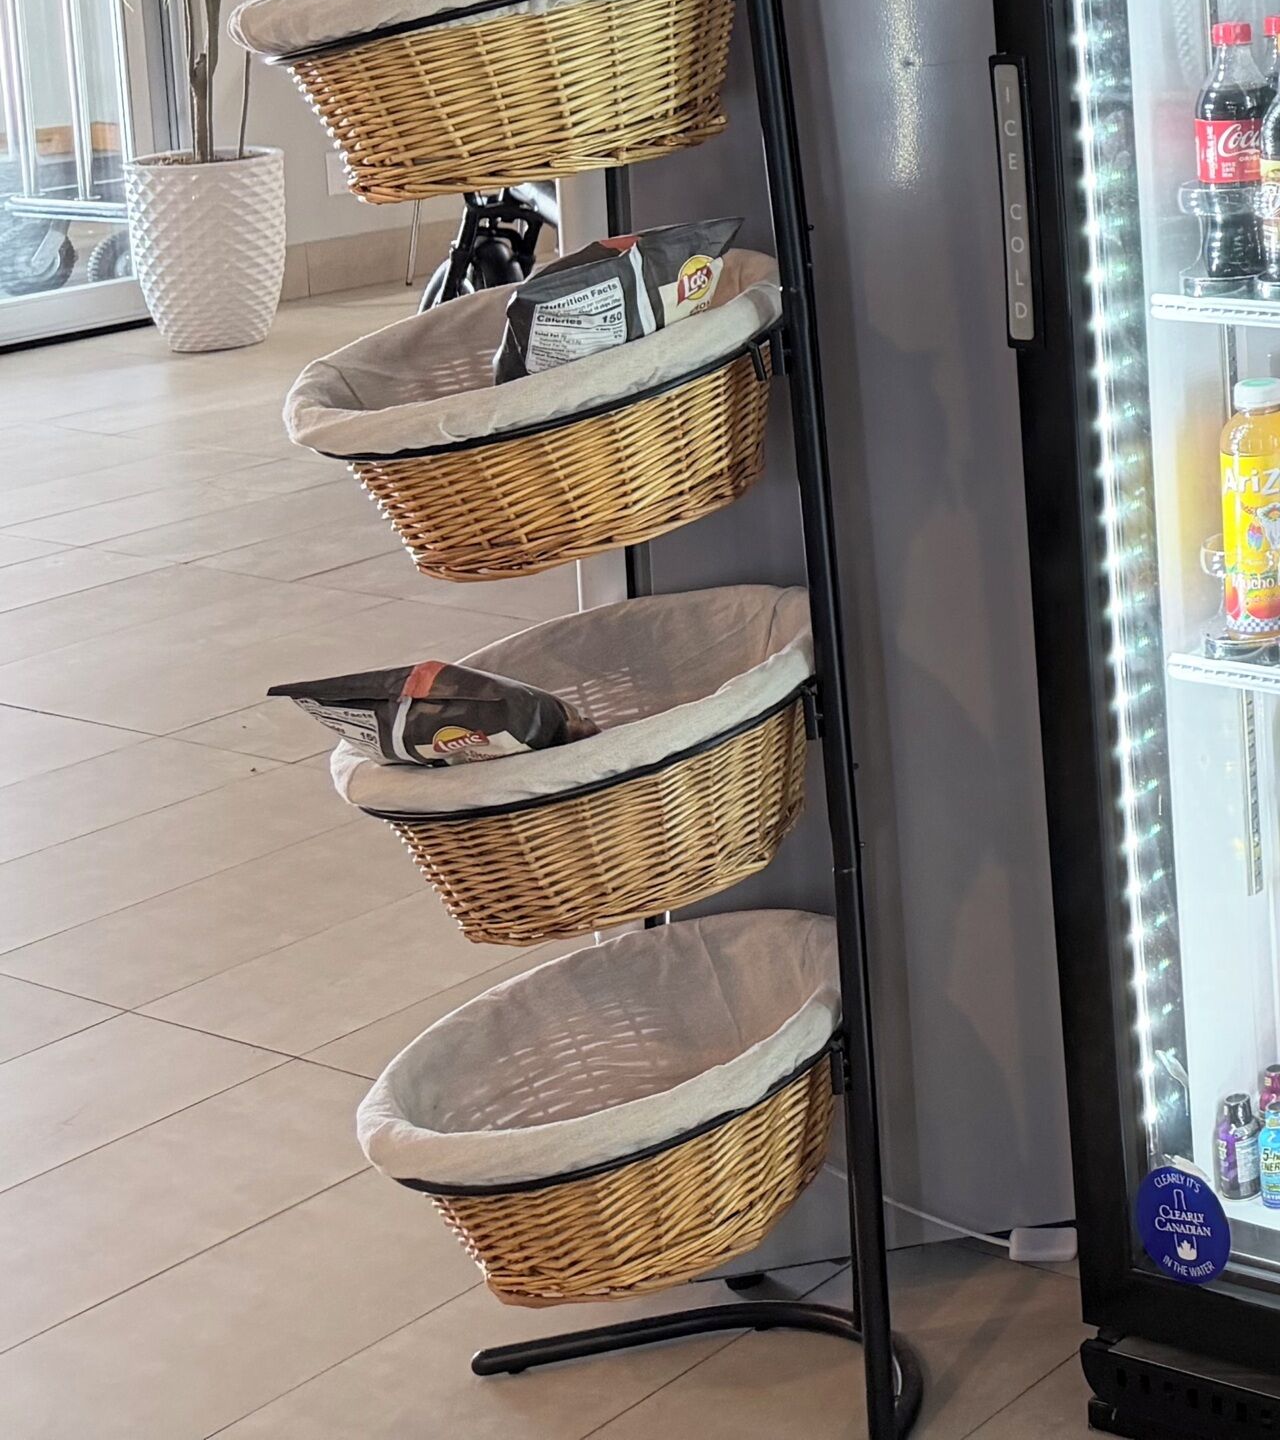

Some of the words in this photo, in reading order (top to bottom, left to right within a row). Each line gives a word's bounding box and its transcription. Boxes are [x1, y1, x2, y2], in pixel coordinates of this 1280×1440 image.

[539, 290, 589, 310] Nutrition
[590, 283, 618, 298] Facts
[602, 312, 623, 324] 150
[1154, 1172, 1185, 1188] CLEARLY
[1159, 1205, 1204, 1224] CLEARLY
[1155, 1218, 1211, 1237] CANADIAN
[1162, 1255, 1172, 1267] IN
[1189, 1261, 1215, 1277] WATER
